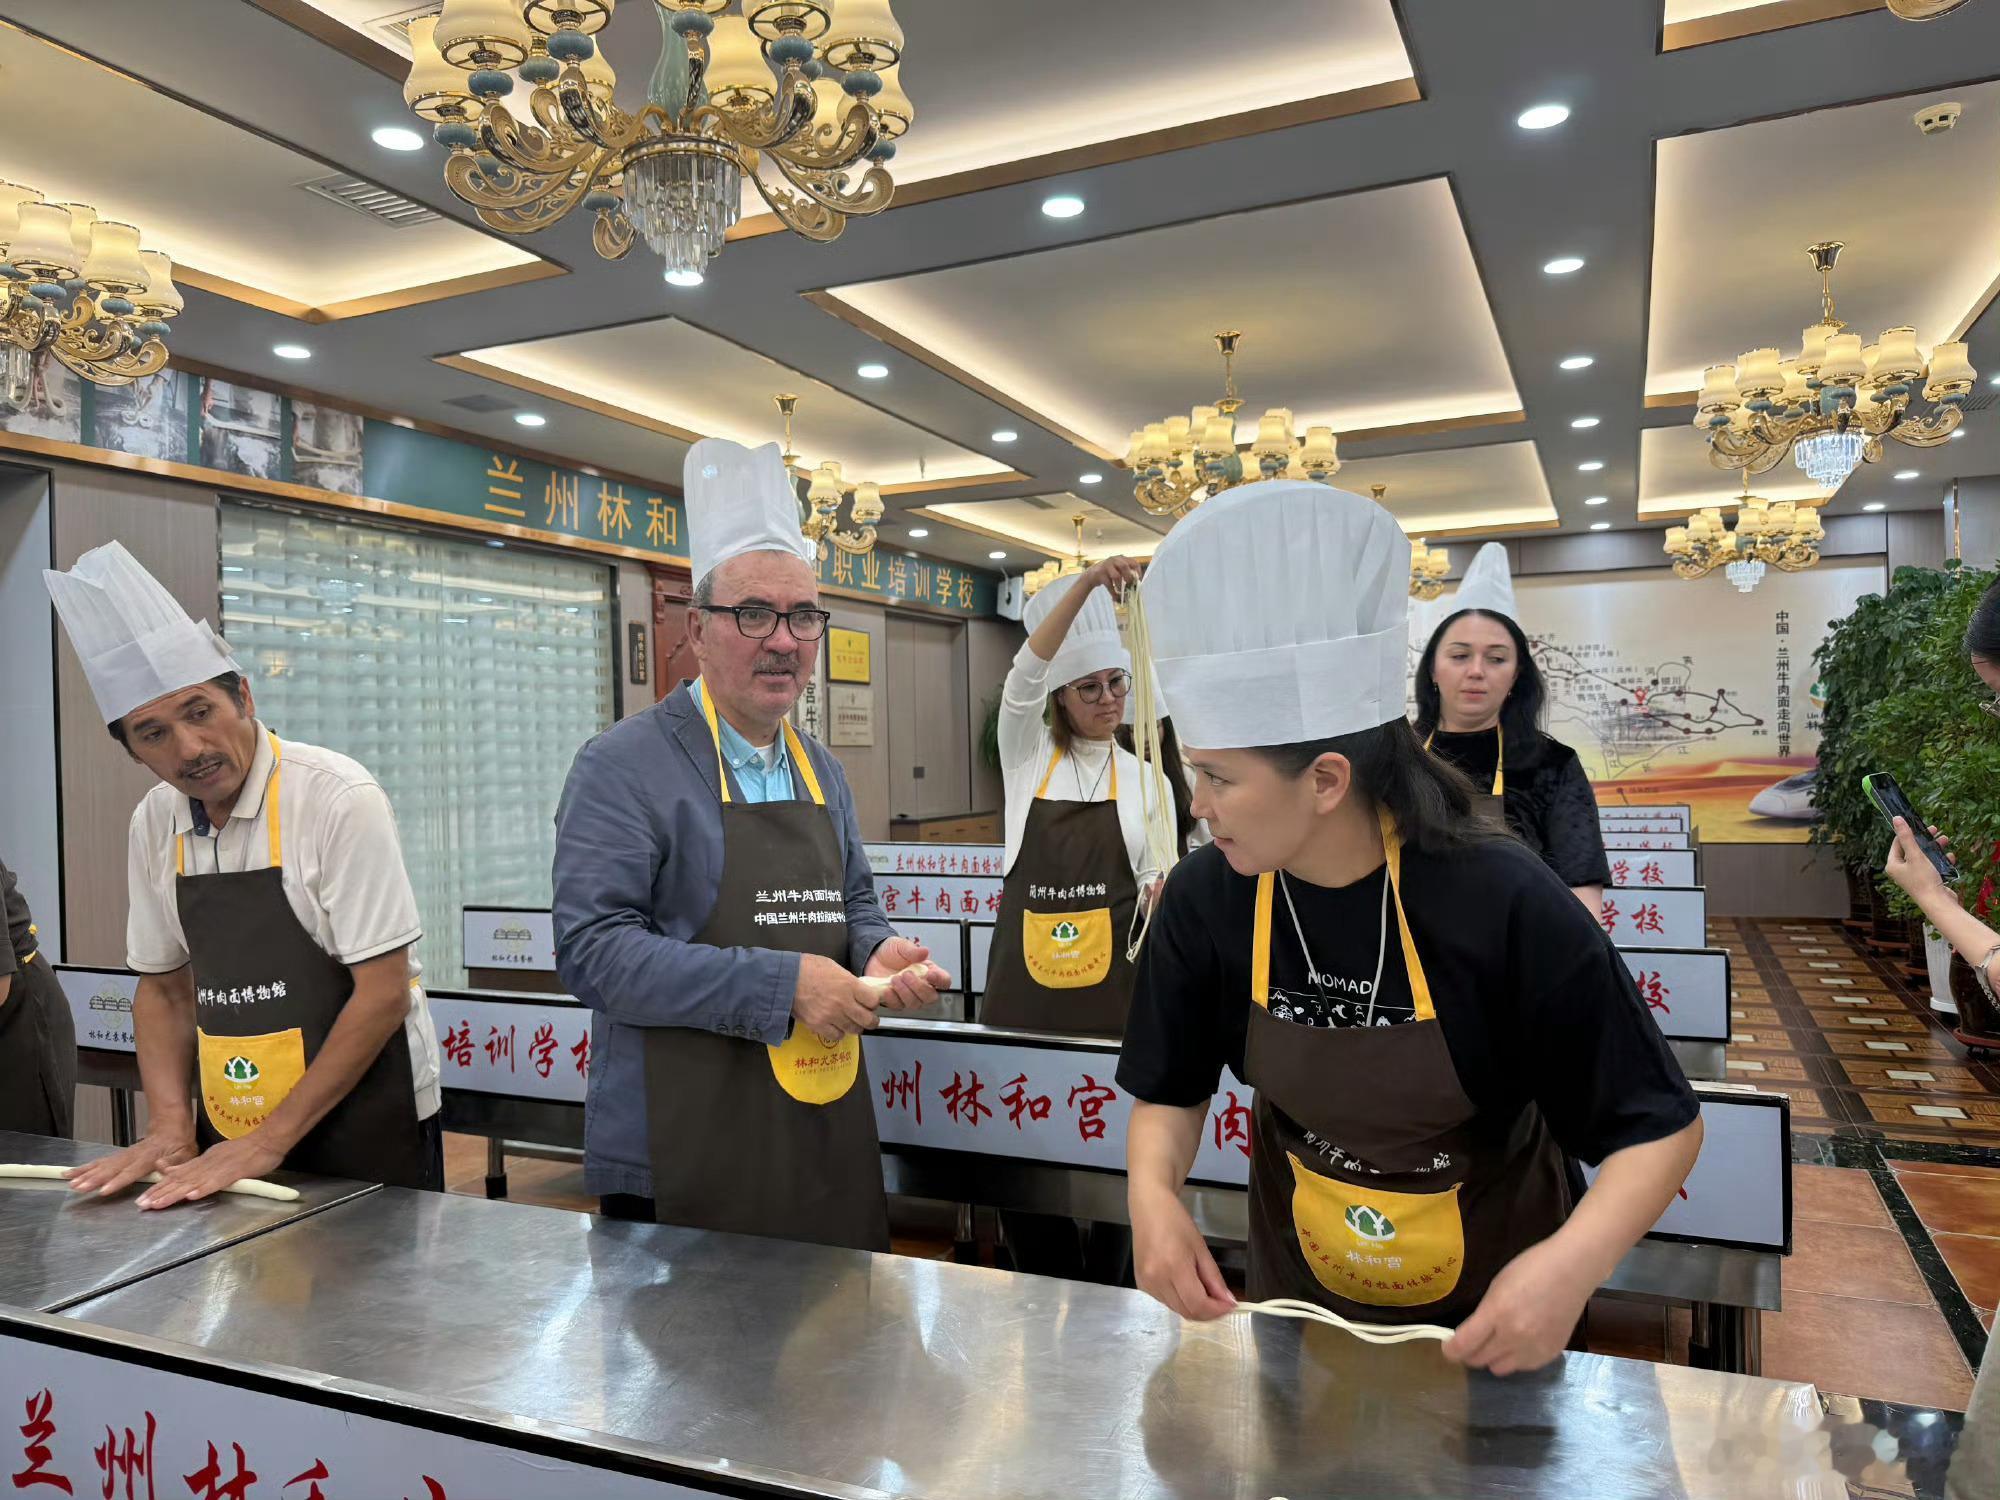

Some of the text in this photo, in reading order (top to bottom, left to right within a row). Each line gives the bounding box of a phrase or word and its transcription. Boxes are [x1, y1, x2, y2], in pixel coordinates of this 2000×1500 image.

[484, 455, 677, 547] 兰州林和
[1600, 899, 1665, 935] 学校
[1308, 971, 1373, 995] NOMAD
[881, 1060, 1251, 1159] 州林和宫 肉
